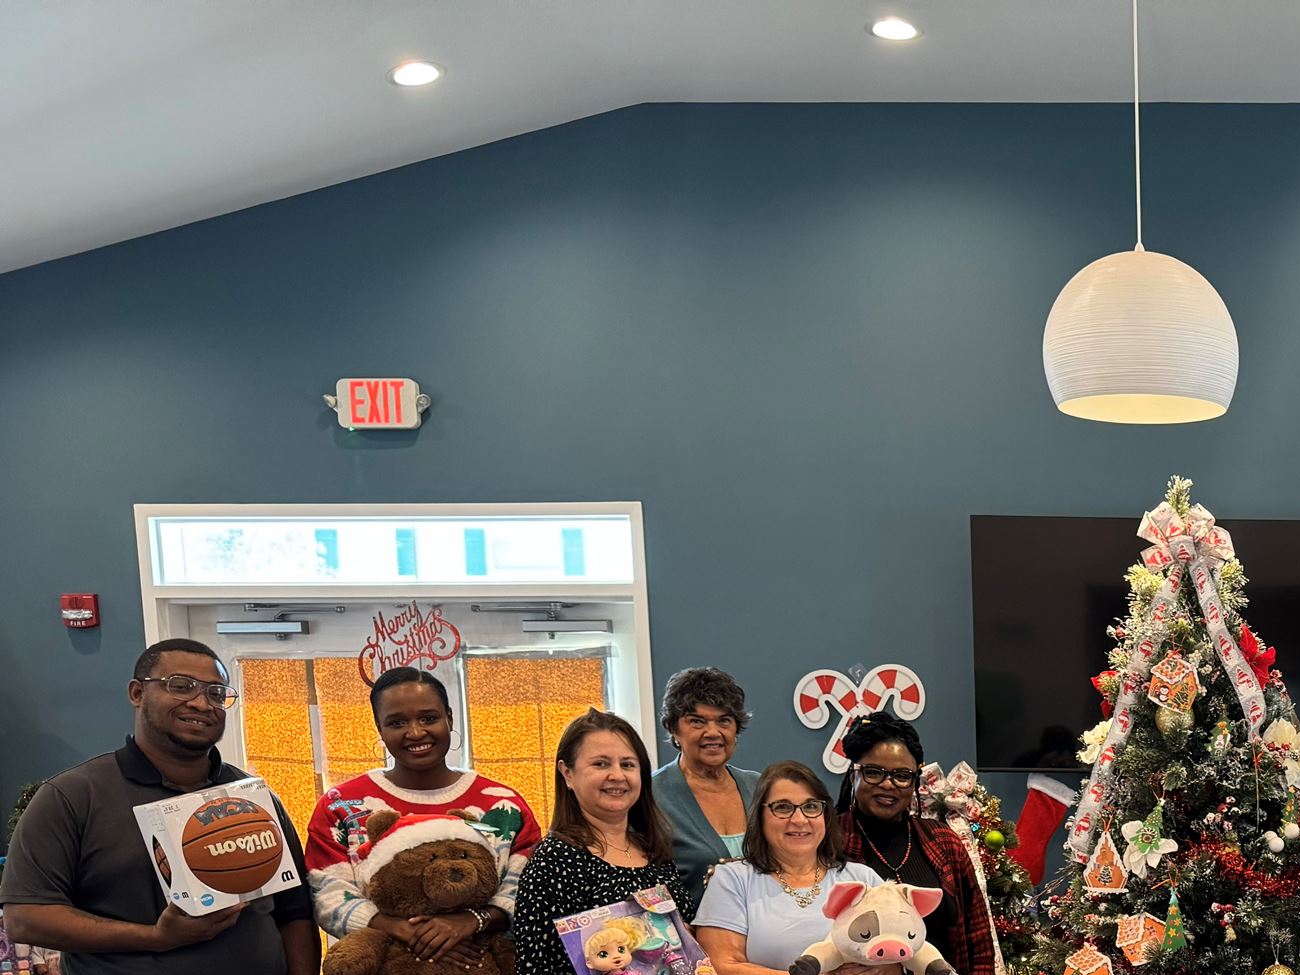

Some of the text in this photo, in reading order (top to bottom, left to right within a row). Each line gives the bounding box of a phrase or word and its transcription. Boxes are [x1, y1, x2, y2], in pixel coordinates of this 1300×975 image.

[349, 380, 404, 423] EXIT
[69, 619, 86, 627] FIRE
[372, 600, 420, 646] Merry
[359, 608, 460, 689] Christmas
